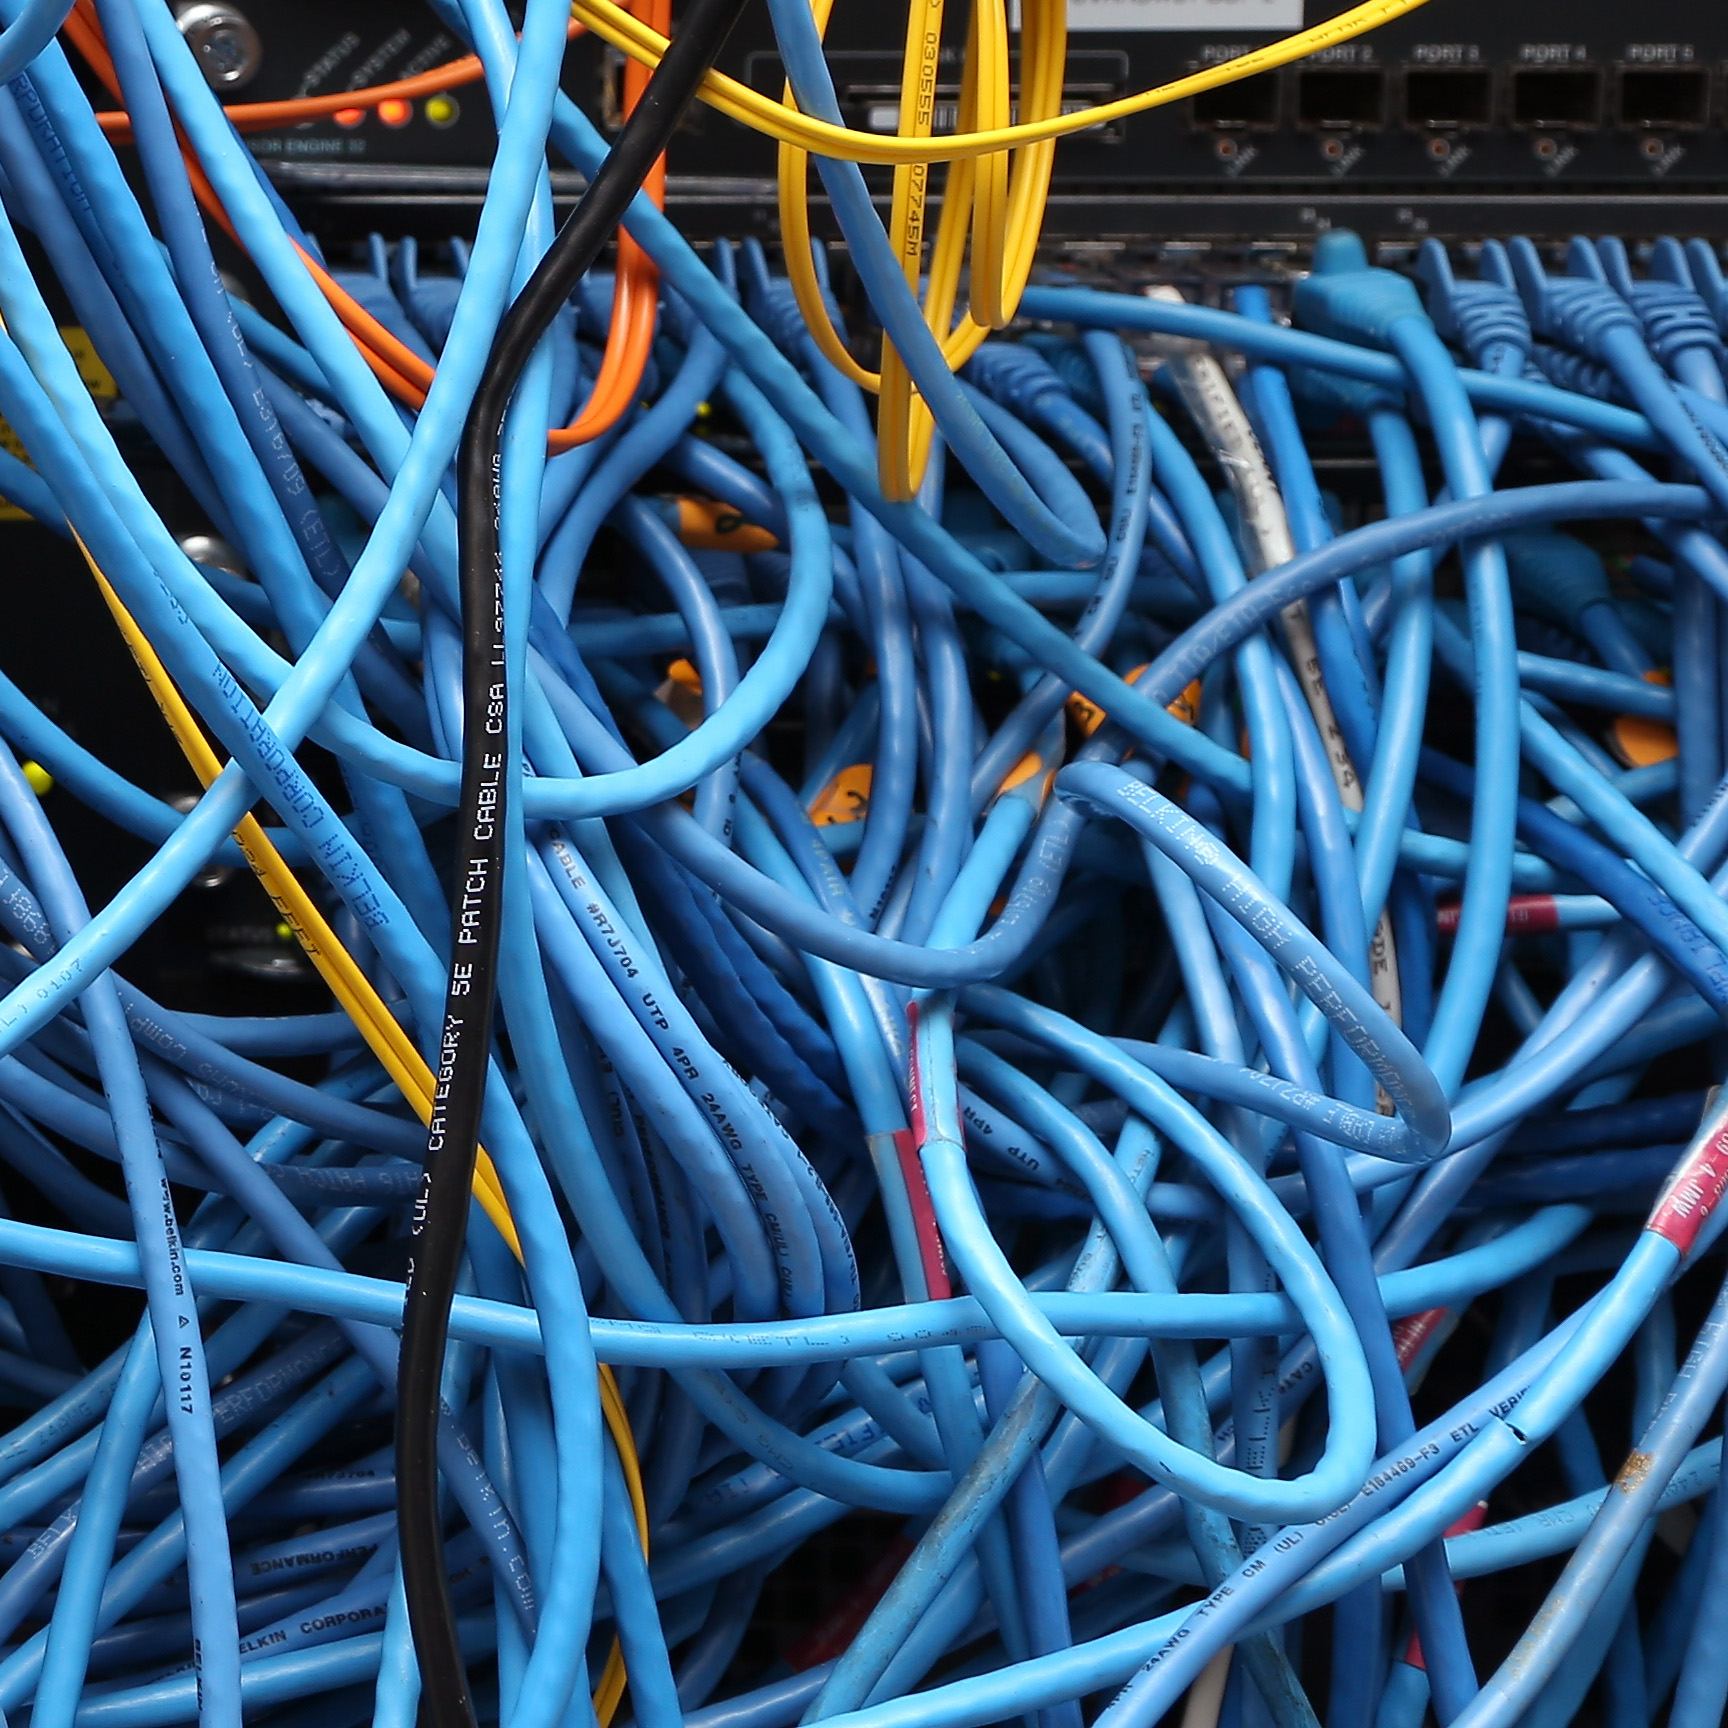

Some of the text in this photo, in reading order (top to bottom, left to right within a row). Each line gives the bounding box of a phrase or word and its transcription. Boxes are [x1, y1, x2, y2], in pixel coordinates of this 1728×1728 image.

[917, 30, 937, 125] 030555
[905, 163, 925, 258] 07745M
[488, 683, 505, 734] CSA
[475, 753, 503, 841] CABLE
[317, 835, 391, 932] BELKIN
[459, 858, 489, 945] PATCH
[452, 962, 471, 995] 5E
[547, 827, 744, 1152] CABLE #R7J704 UTP 4PR 24AWG
[429, 1013, 463, 1150] CATEGORY
[178, 1346, 195, 1415] N10117
[1142, 1422, 1479, 1672] 24AWG TYPE CM (UL) E164469-F3 ETL
